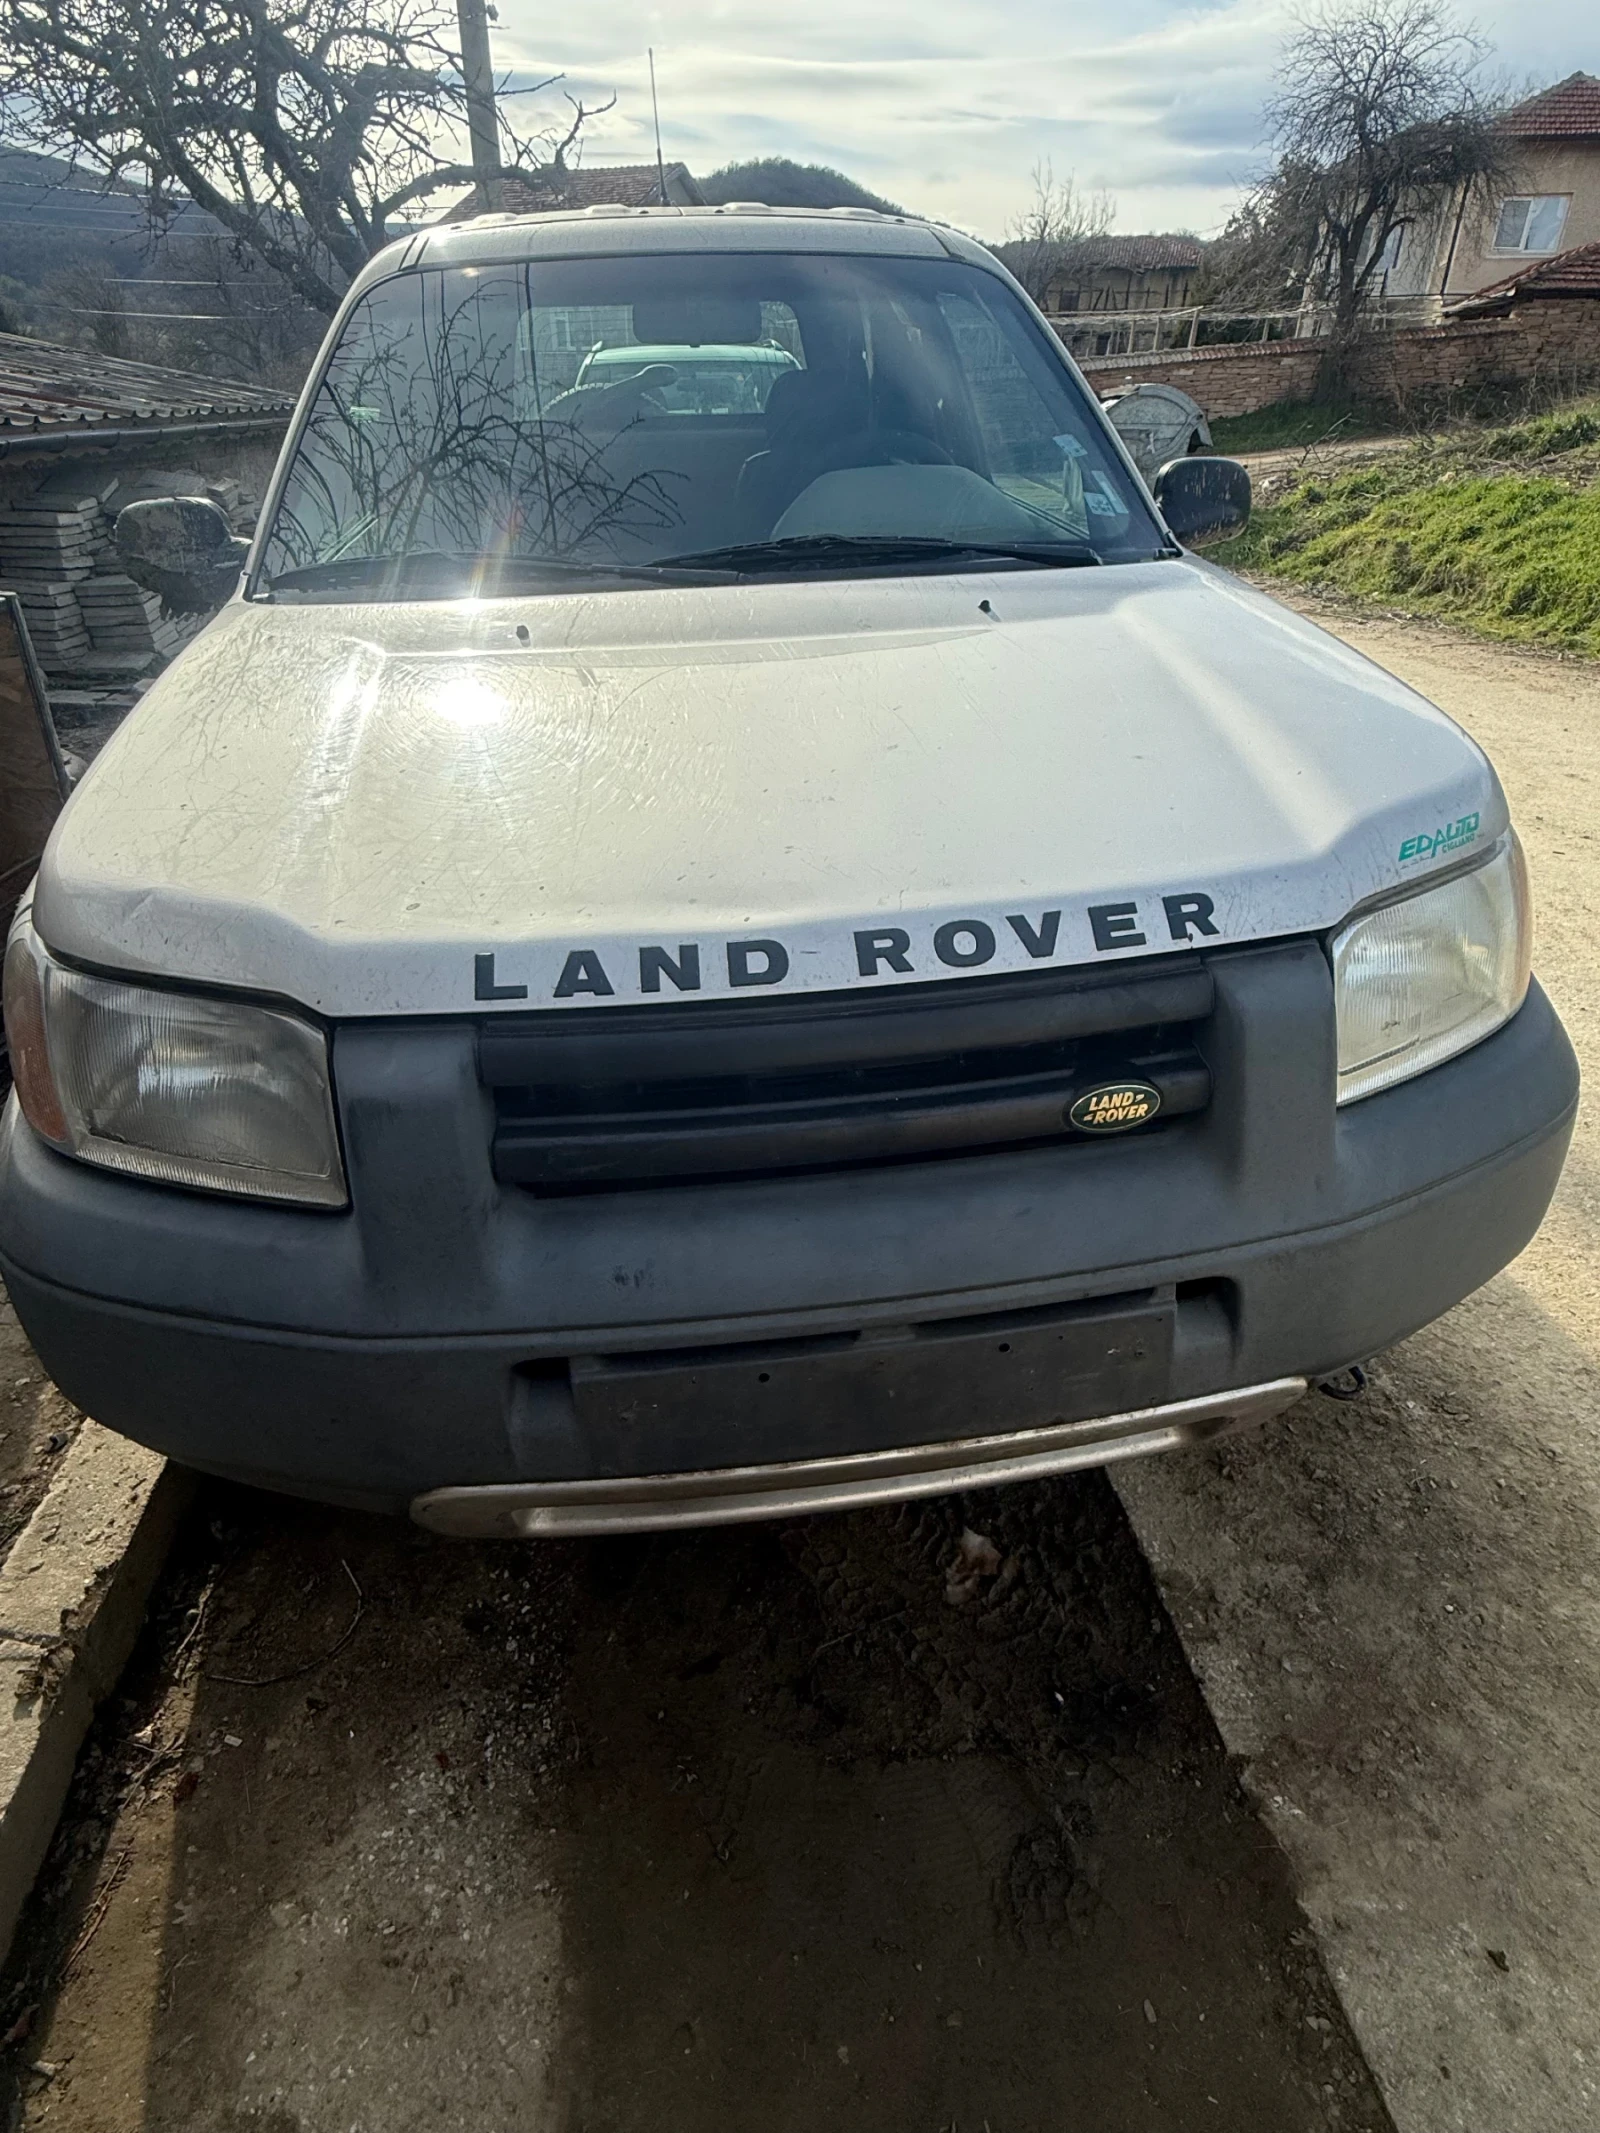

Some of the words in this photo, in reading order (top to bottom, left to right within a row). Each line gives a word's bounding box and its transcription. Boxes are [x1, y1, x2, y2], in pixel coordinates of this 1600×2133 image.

[474, 939, 789, 1001] LAND
[853, 892, 1220, 977] ROVER
[1088, 1091, 1135, 1112] LAND
[1093, 1103, 1149, 1125] ROVER
